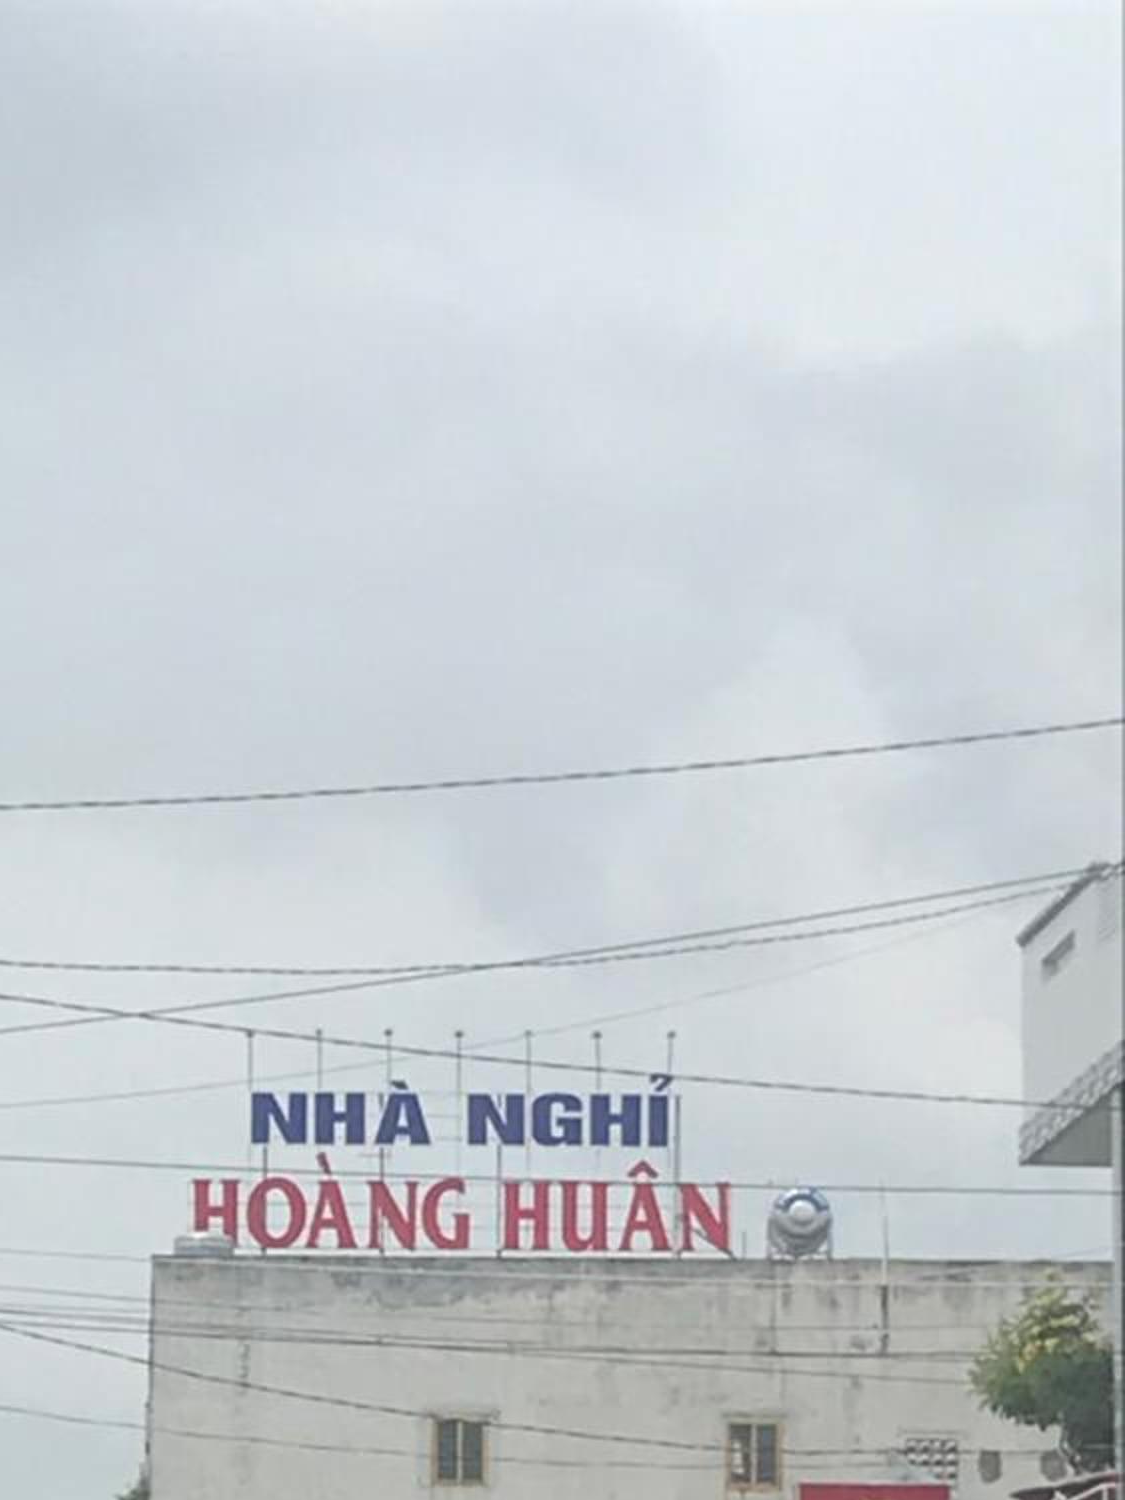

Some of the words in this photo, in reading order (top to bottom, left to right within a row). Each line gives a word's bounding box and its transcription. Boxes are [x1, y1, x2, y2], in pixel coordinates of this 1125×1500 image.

[251, 1081, 430, 1146] NHÀ
[467, 1074, 673, 1148] NGHỈ
[192, 1153, 471, 1251] HOÀNG
[502, 1160, 731, 1252] HUÂN
